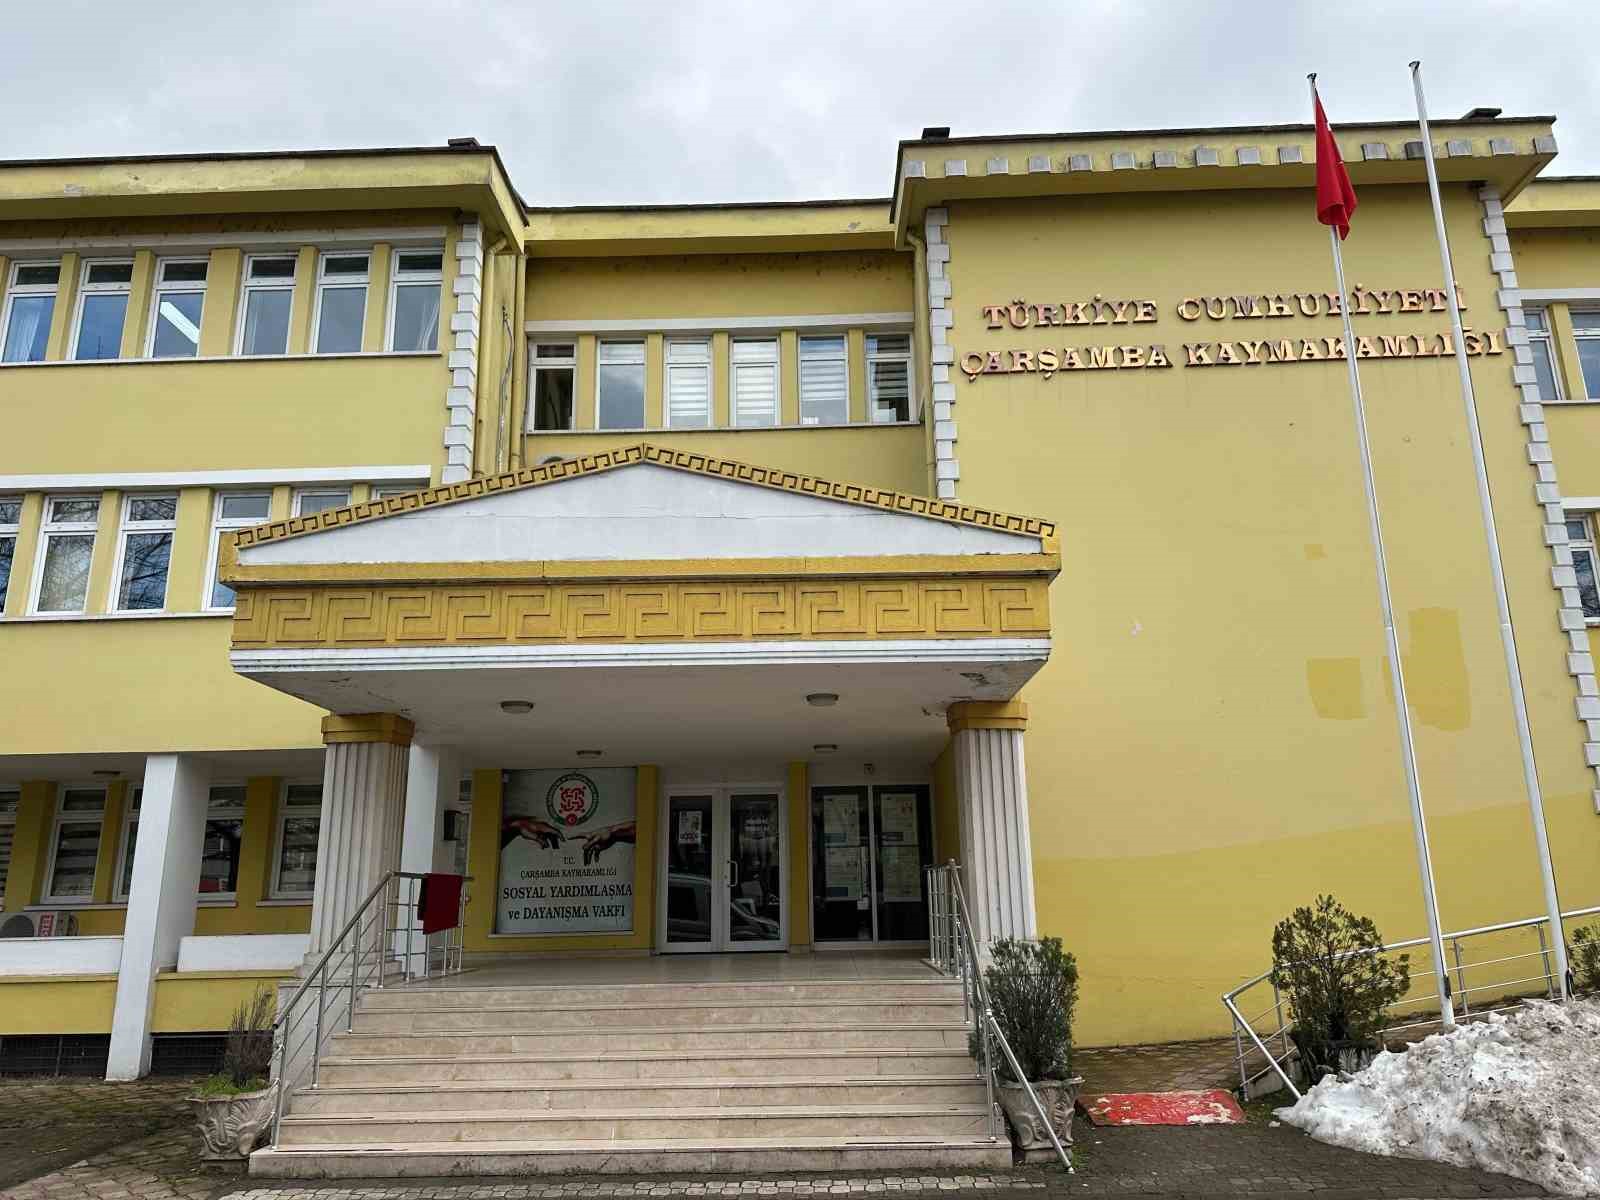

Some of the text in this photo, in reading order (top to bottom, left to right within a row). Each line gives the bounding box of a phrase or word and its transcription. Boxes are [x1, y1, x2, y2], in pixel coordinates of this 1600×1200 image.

[983, 281, 1467, 329] TÜRKİYE CUMHURİYETİ
[960, 326, 1503, 381] ÇARŞAMBA KAYMAKAMLIĞI
[503, 884, 632, 900] SOSYAL YARDIMLAŞMA
[508, 905, 625, 921] ve DAYANIŞMA VAKFI
